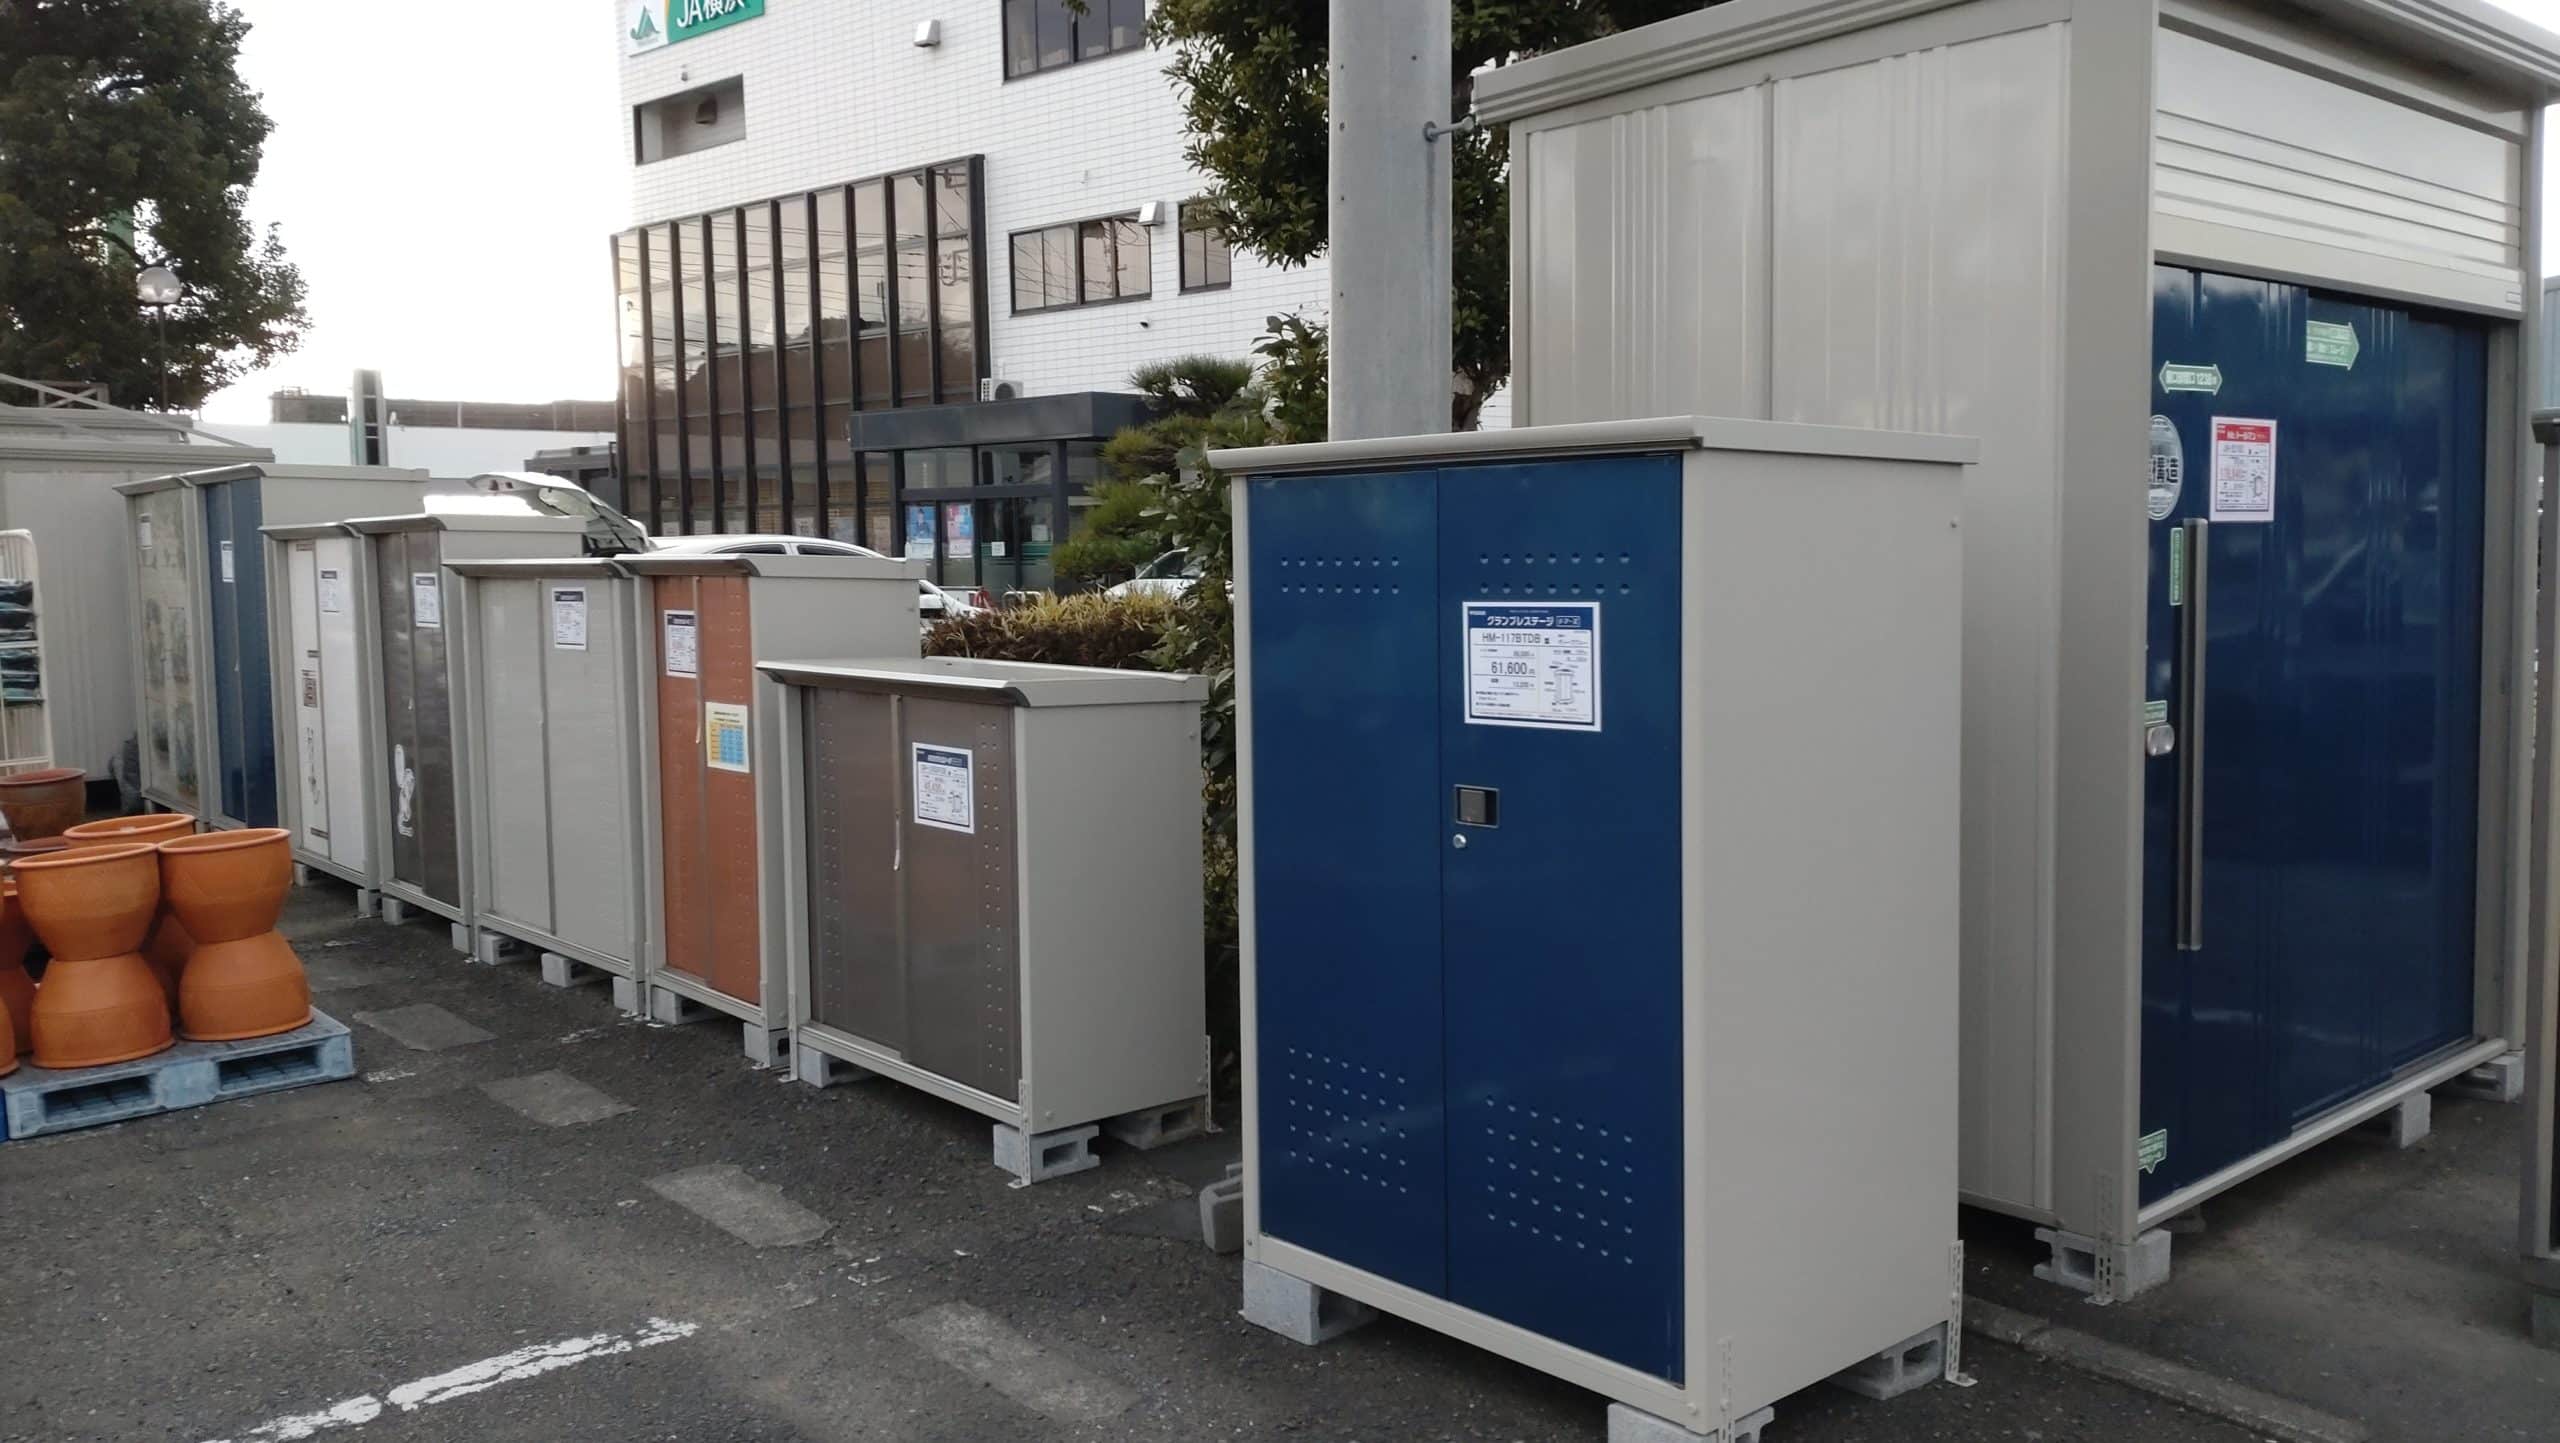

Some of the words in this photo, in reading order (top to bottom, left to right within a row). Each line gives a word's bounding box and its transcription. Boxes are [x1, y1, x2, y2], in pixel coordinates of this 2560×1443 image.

[1487, 615, 1554, 626] グランプレステージ
